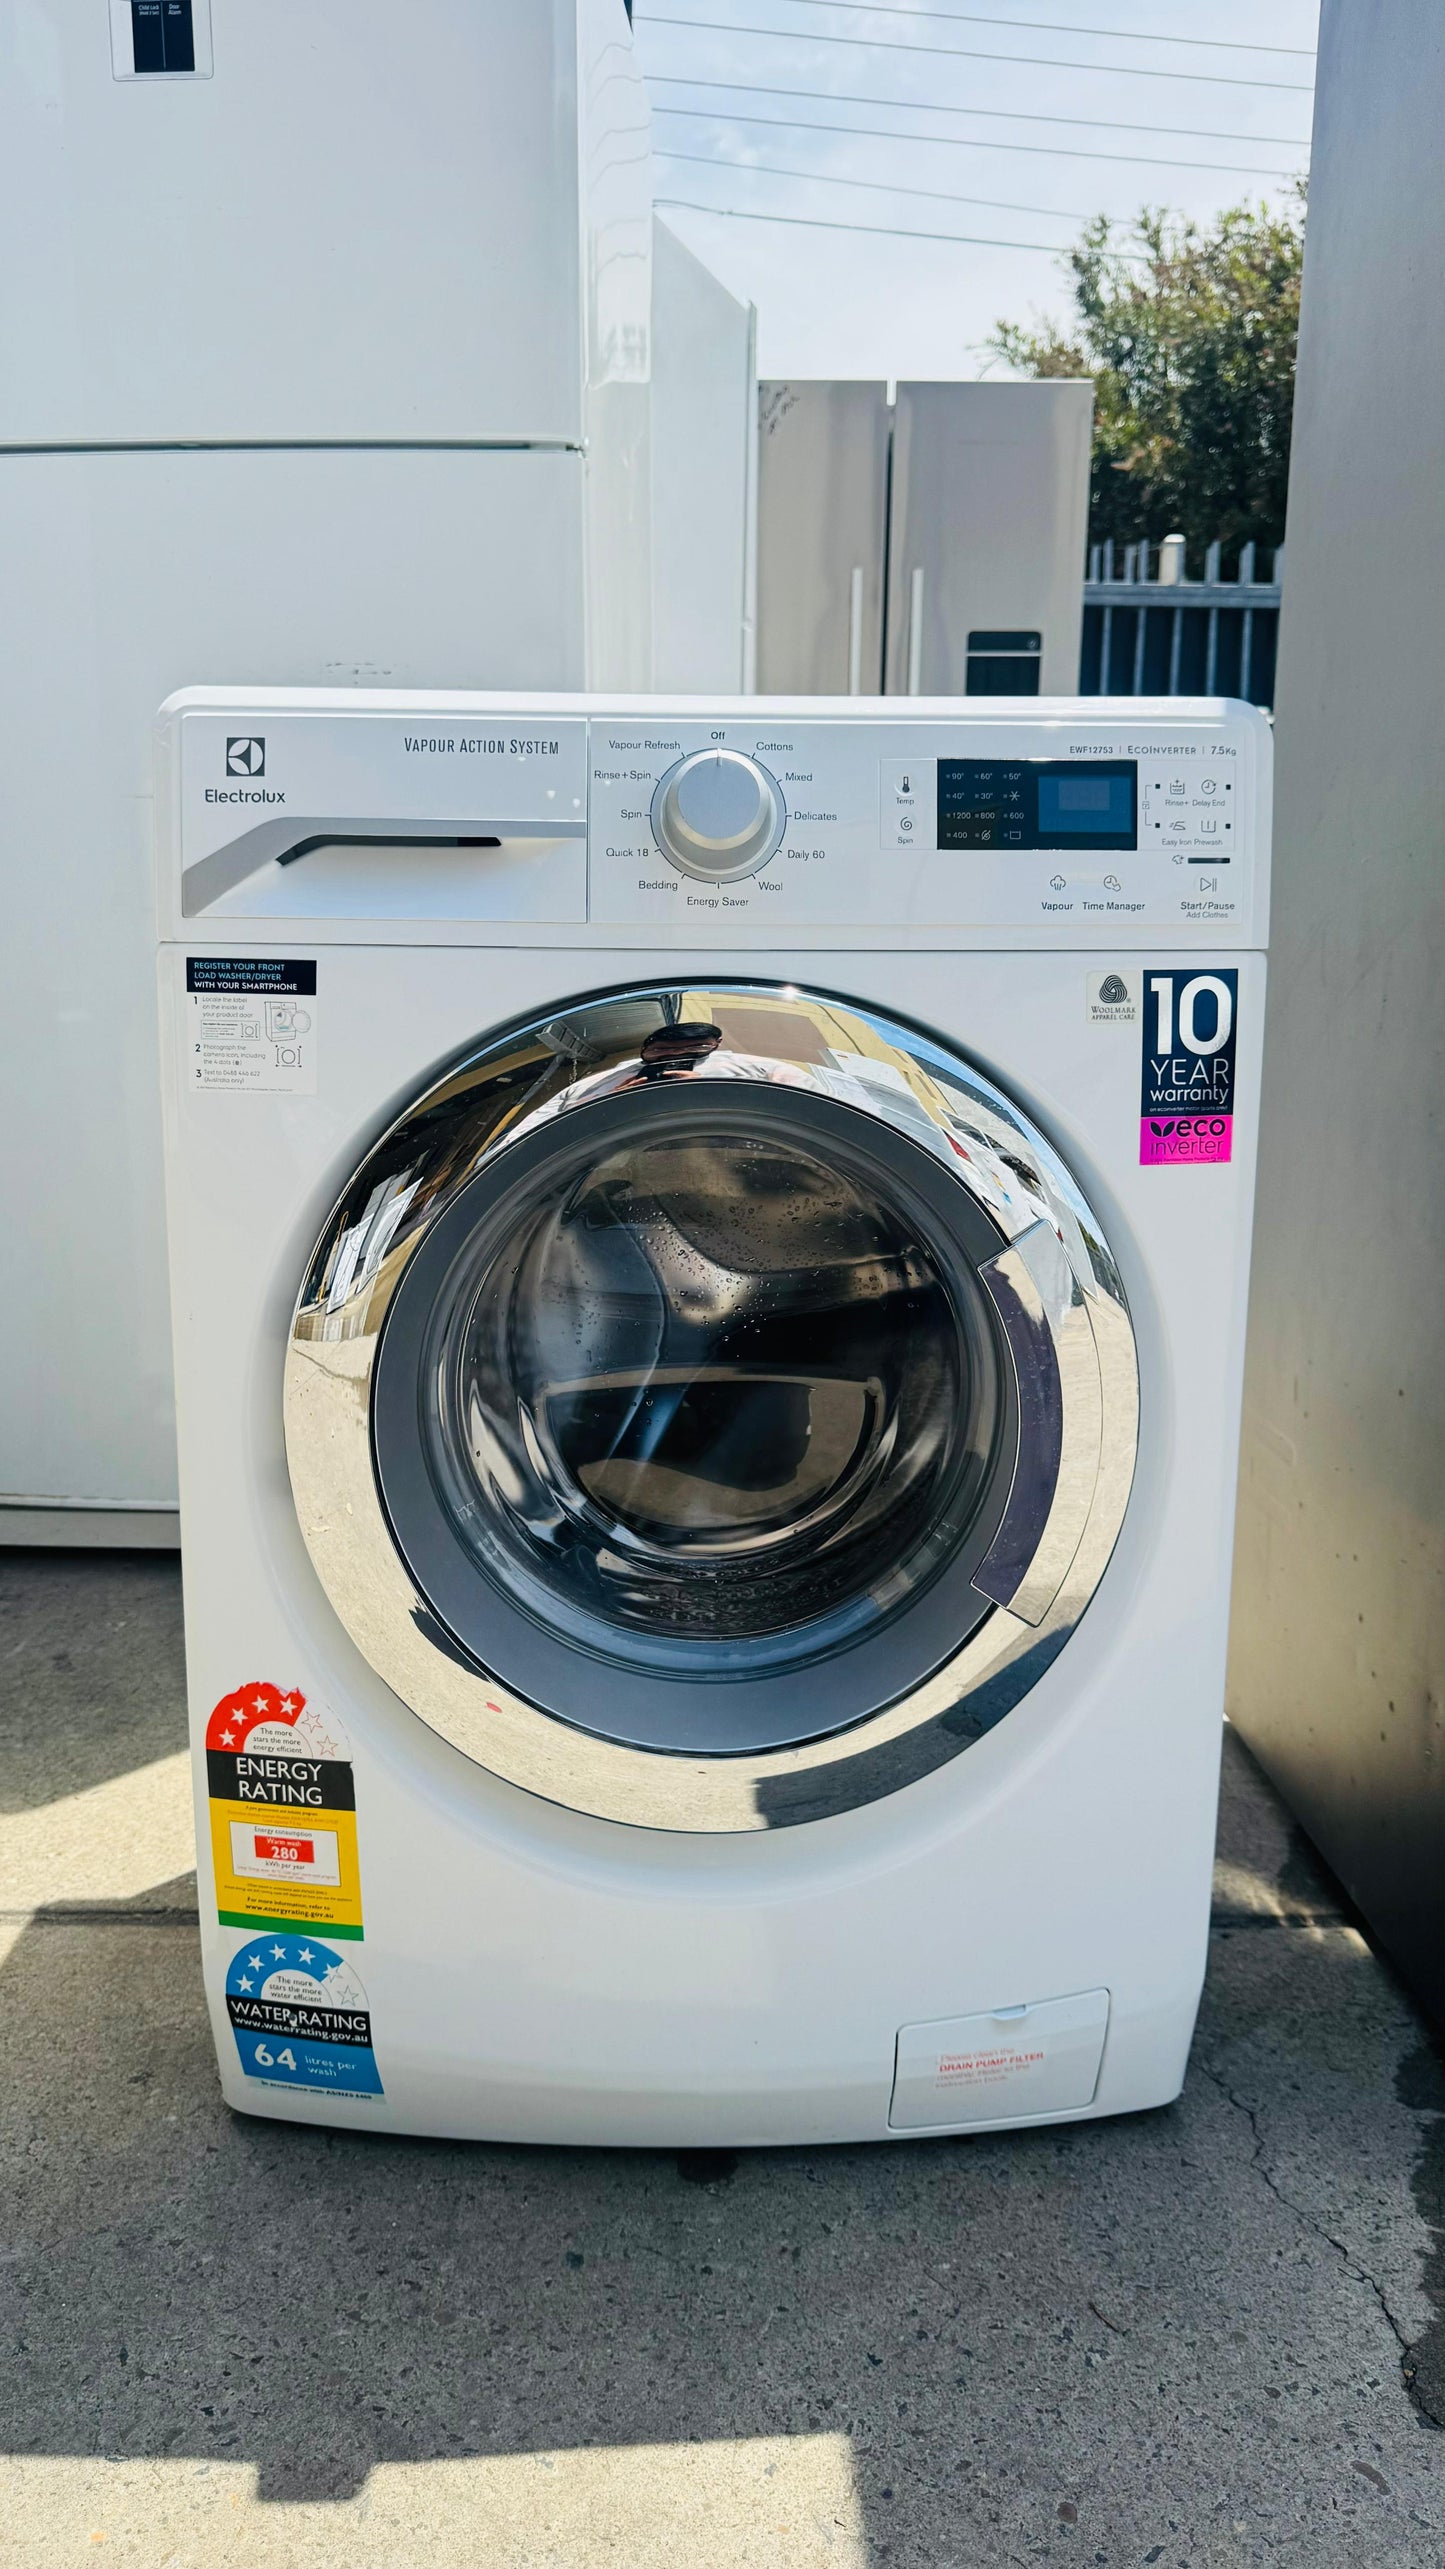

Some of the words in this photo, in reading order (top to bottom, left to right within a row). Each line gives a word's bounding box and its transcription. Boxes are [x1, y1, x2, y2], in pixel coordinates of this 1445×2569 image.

[711, 731, 725, 739] Off
[404, 737, 454, 753] VAPOUR
[460, 738, 505, 754] ACTION
[510, 739, 559, 755] SYSTEM
[609, 741, 641, 750] Vapour
[645, 741, 680, 749] Refresh
[756, 742, 793, 751] Cottons
[1070, 746, 1113, 754] EWF12753
[785, 773, 812, 781] Mixed
[205, 789, 286, 804] Electrolux
[896, 798, 914, 806] Temp
[621, 810, 642, 819] Spin
[794, 812, 837, 821] Delicates
[898, 837, 913, 845] Spin
[606, 849, 633, 858] Quick
[637, 849, 649, 857] 18
[788, 850, 809, 860] Daily
[813, 850, 825, 859] 60
[639, 881, 678, 891] Bedding
[759, 882, 783, 891] Wool
[687, 897, 719, 908] Energy
[722, 898, 749, 906] Saver
[1041, 902, 1073, 911] Vapour
[1083, 902, 1104, 910] Time
[1107, 902, 1145, 912] Manager
[1181, 902, 1235, 910] Start/Pause
[194, 962, 231, 970] REGISTER
[218, 972, 281, 981] WASHER/DRYER
[242, 982, 297, 991] SMARTPHONE
[194, 996, 198, 1005] 1
[1150, 975, 1232, 1055] 10
[195, 1044, 201, 1052] 2
[196, 1069, 202, 1078] 3
[1151, 1058, 1229, 1086] YEAR
[1150, 1085, 1229, 1105] warranty
[1177, 1119, 1225, 1137] eco
[1151, 1137, 1224, 1155] inverter
[261, 1727, 273, 1735] The
[236, 1757, 322, 1781] ENERGY
[239, 1781, 323, 1805] RATING
[255, 1826, 273, 1834] Energy
[267, 1838, 285, 1846] Warm
[271, 1846, 298, 1860] 280
[246, 1904, 334, 1919] www.energyrating.gov.au
[277, 1976, 290, 1984] The
[294, 1994, 321, 2003] efficient
[231, 2001, 292, 2021] WATER
[299, 2010, 366, 2031] RATING
[234, 2016, 368, 2043] www.waterrating.gov.au
[255, 2044, 297, 2071] 64
[940, 2062, 973, 2072] DRAIN
[976, 2057, 1007, 2068] PUMP
[1010, 2052, 1043, 2063] FILTER
[305, 2055, 333, 2068] litres
[337, 2060, 357, 2070] per
[308, 2066, 337, 2077] wash
